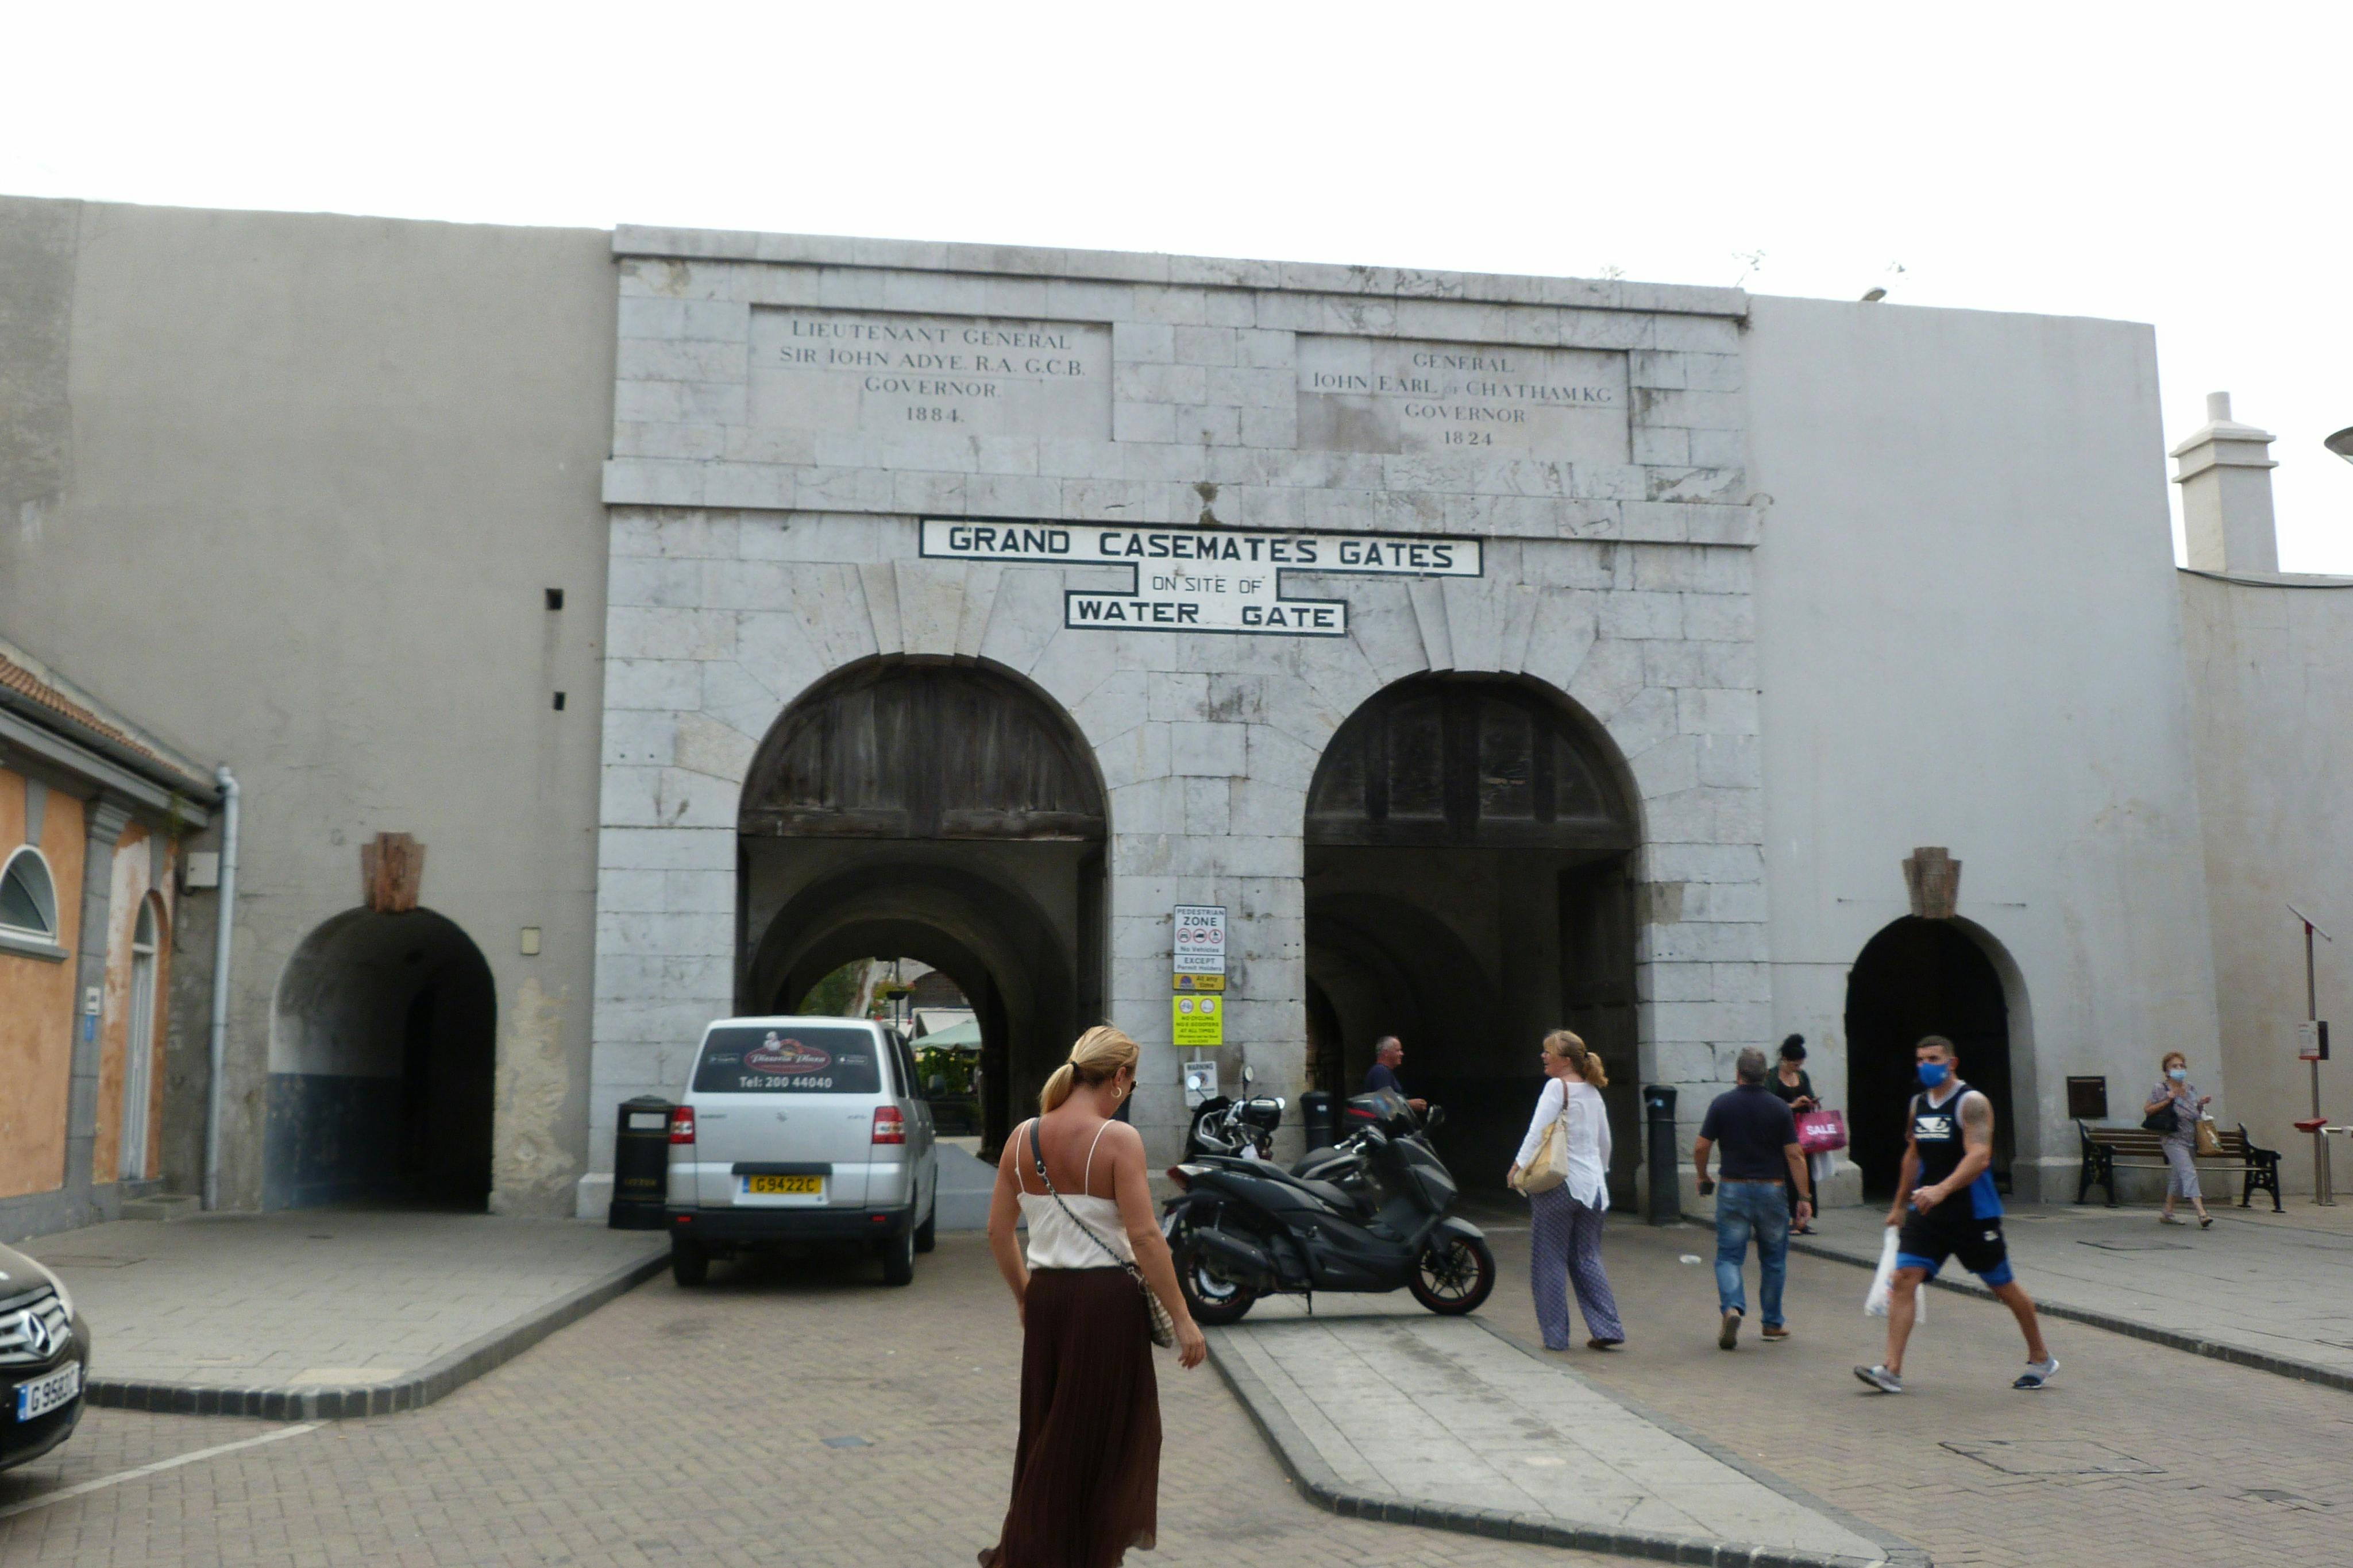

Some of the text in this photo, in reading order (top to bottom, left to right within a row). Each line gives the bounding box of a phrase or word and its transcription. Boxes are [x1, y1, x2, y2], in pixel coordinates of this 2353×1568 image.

[793, 319, 1071, 350] LIEUTENANT GENERAL
[780, 346, 816, 362] SIR
[1413, 352, 1515, 373] GENERAL
[1379, 375, 1437, 393] EARL
[1405, 403, 1525, 423] GOVERNOR
[1445, 430, 1493, 446] 1824
[949, 526, 1453, 568] GRAND CASEMATES GATES
[1153, 576, 1262, 594] ON SITE OF
[1078, 601, 1334, 627] WATER GATE
[1183, 917, 1217, 926] ZONE
[766, 1076, 789, 1088] 200
[792, 1076, 833, 1088] 44040
[1806, 1123, 1837, 1136] SALE
